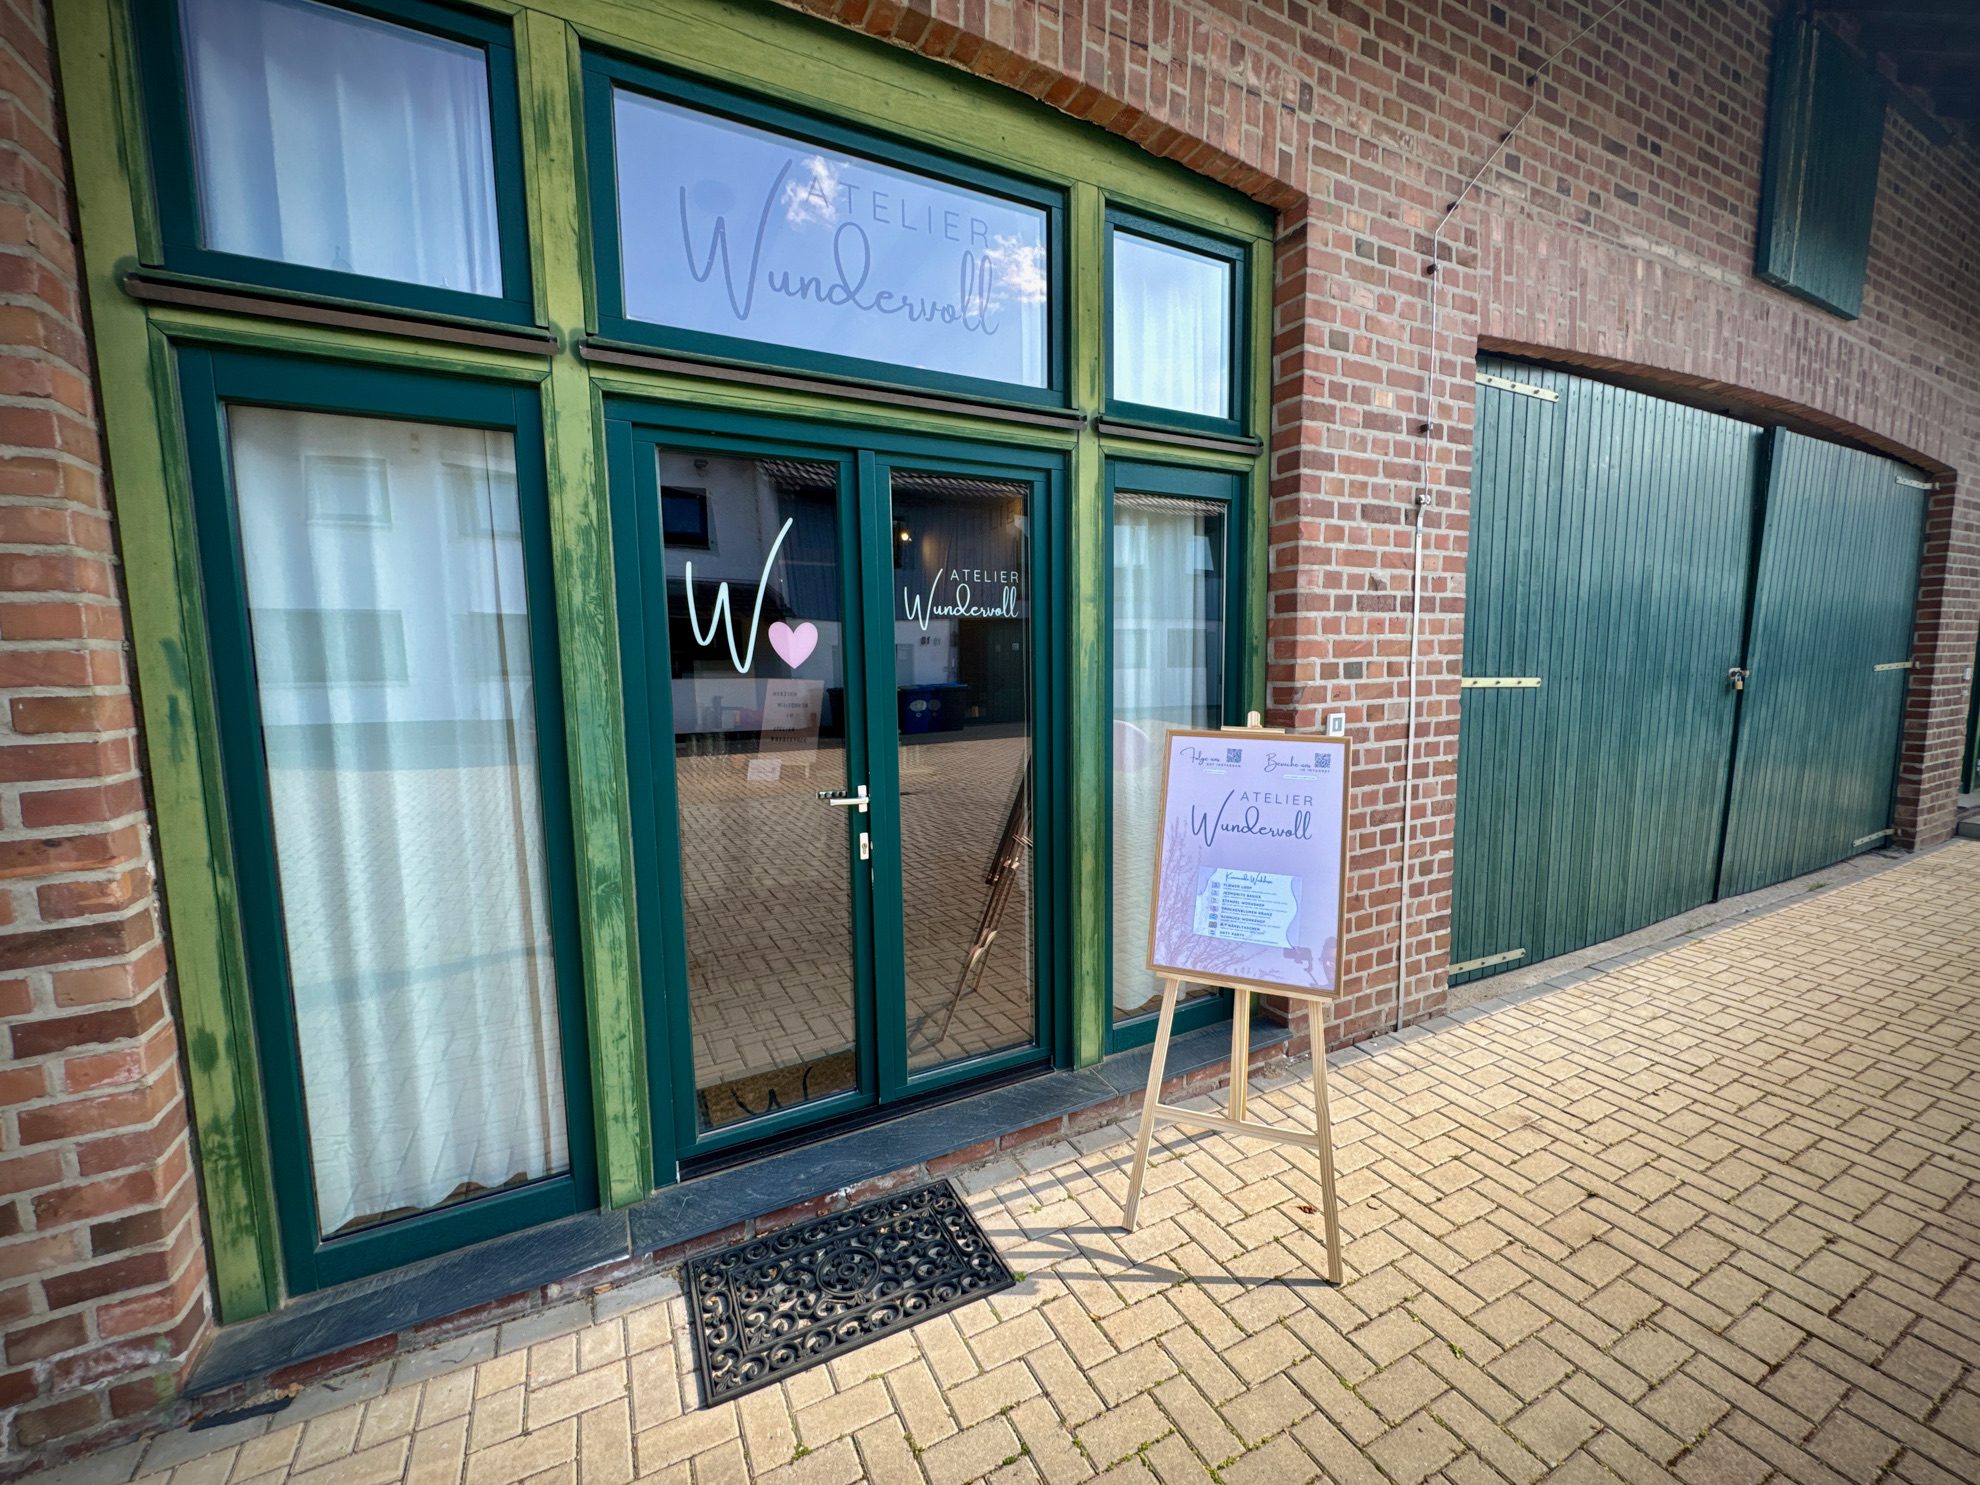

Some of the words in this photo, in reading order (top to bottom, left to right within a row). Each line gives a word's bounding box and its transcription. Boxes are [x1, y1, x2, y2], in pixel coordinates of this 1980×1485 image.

[806, 176, 990, 248] ATELIER
[679, 158, 1000, 336] Wundervoll
[686, 517, 794, 674] W
[904, 568, 1019, 631] Wundervoll
[950, 569, 1019, 584] ATELIER
[1191, 789, 1313, 847] Wundervoll
[1240, 791, 1313, 806] ATELIER
